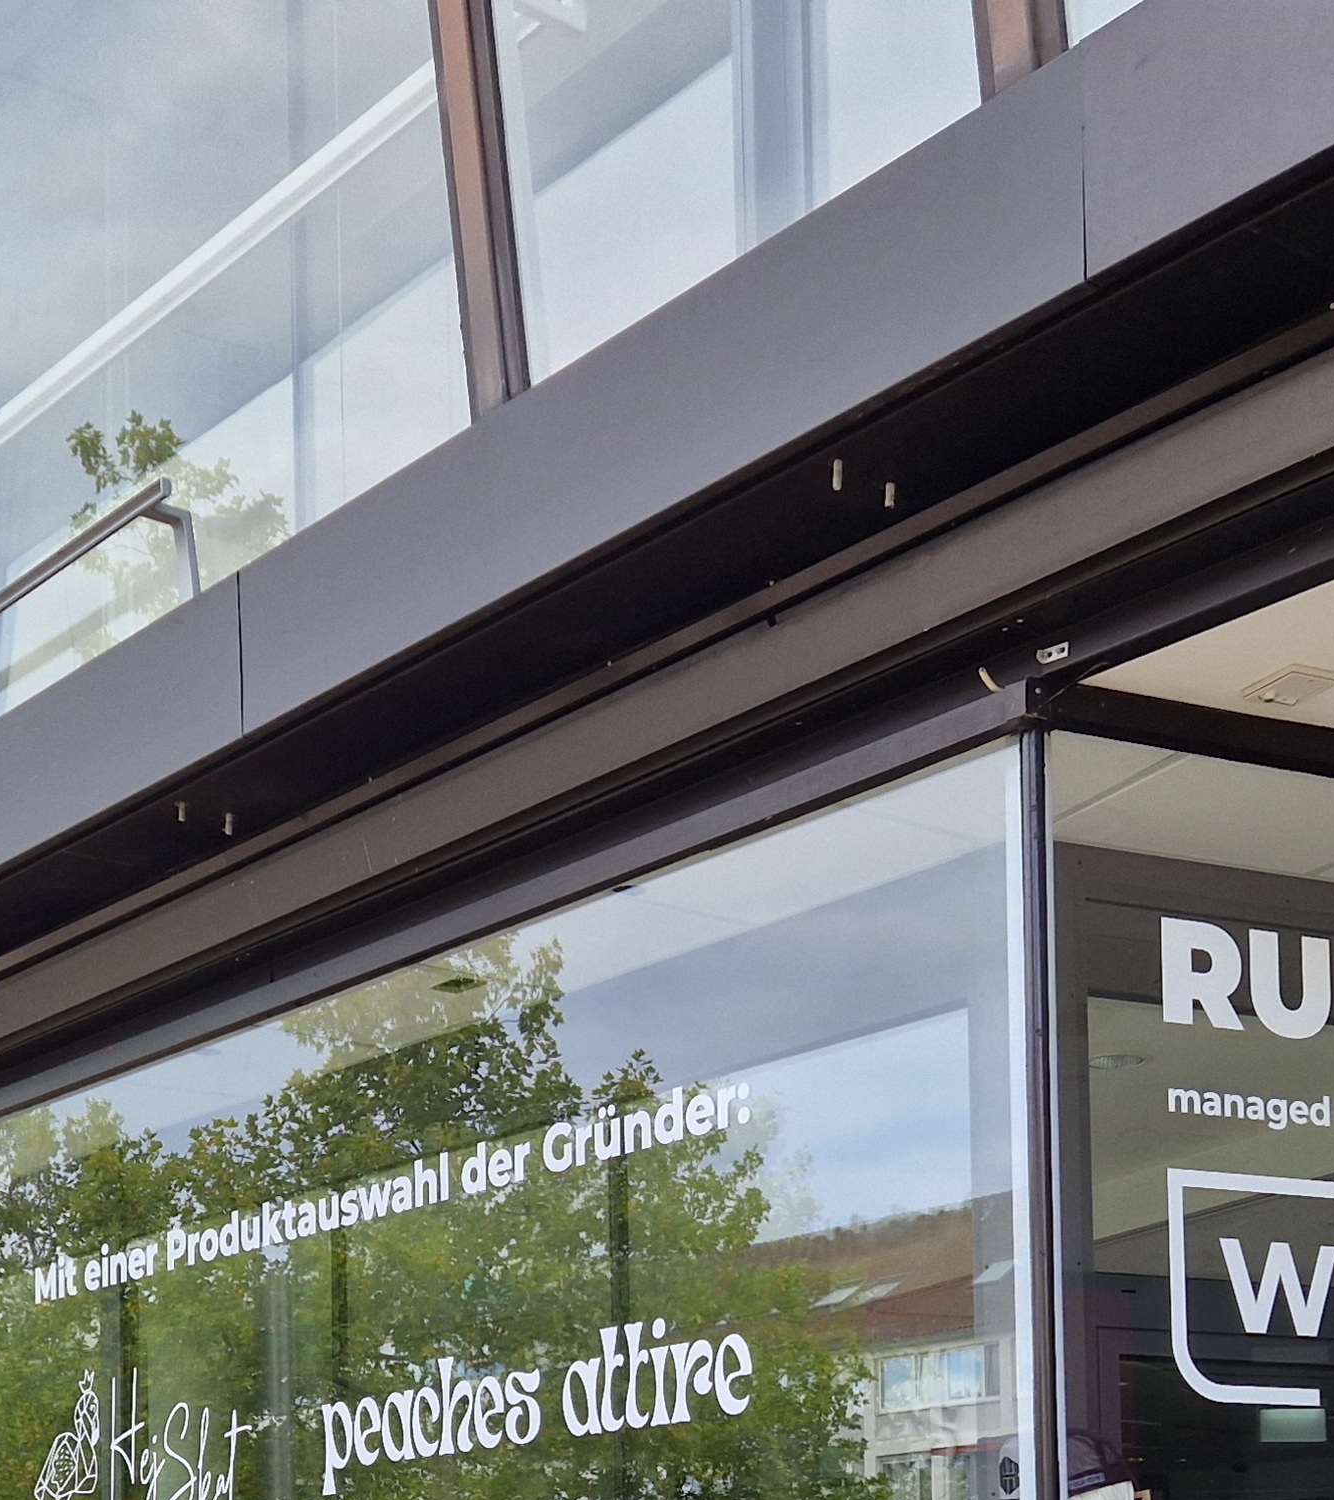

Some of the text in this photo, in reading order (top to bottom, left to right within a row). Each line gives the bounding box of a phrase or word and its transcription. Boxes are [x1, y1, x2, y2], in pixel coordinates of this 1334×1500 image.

[34, 1081, 752, 1305] Mit einer Produktauswahl der Gründer:
[1167, 1087, 1332, 1130] managed
[321, 1316, 753, 1496] peaches attire
